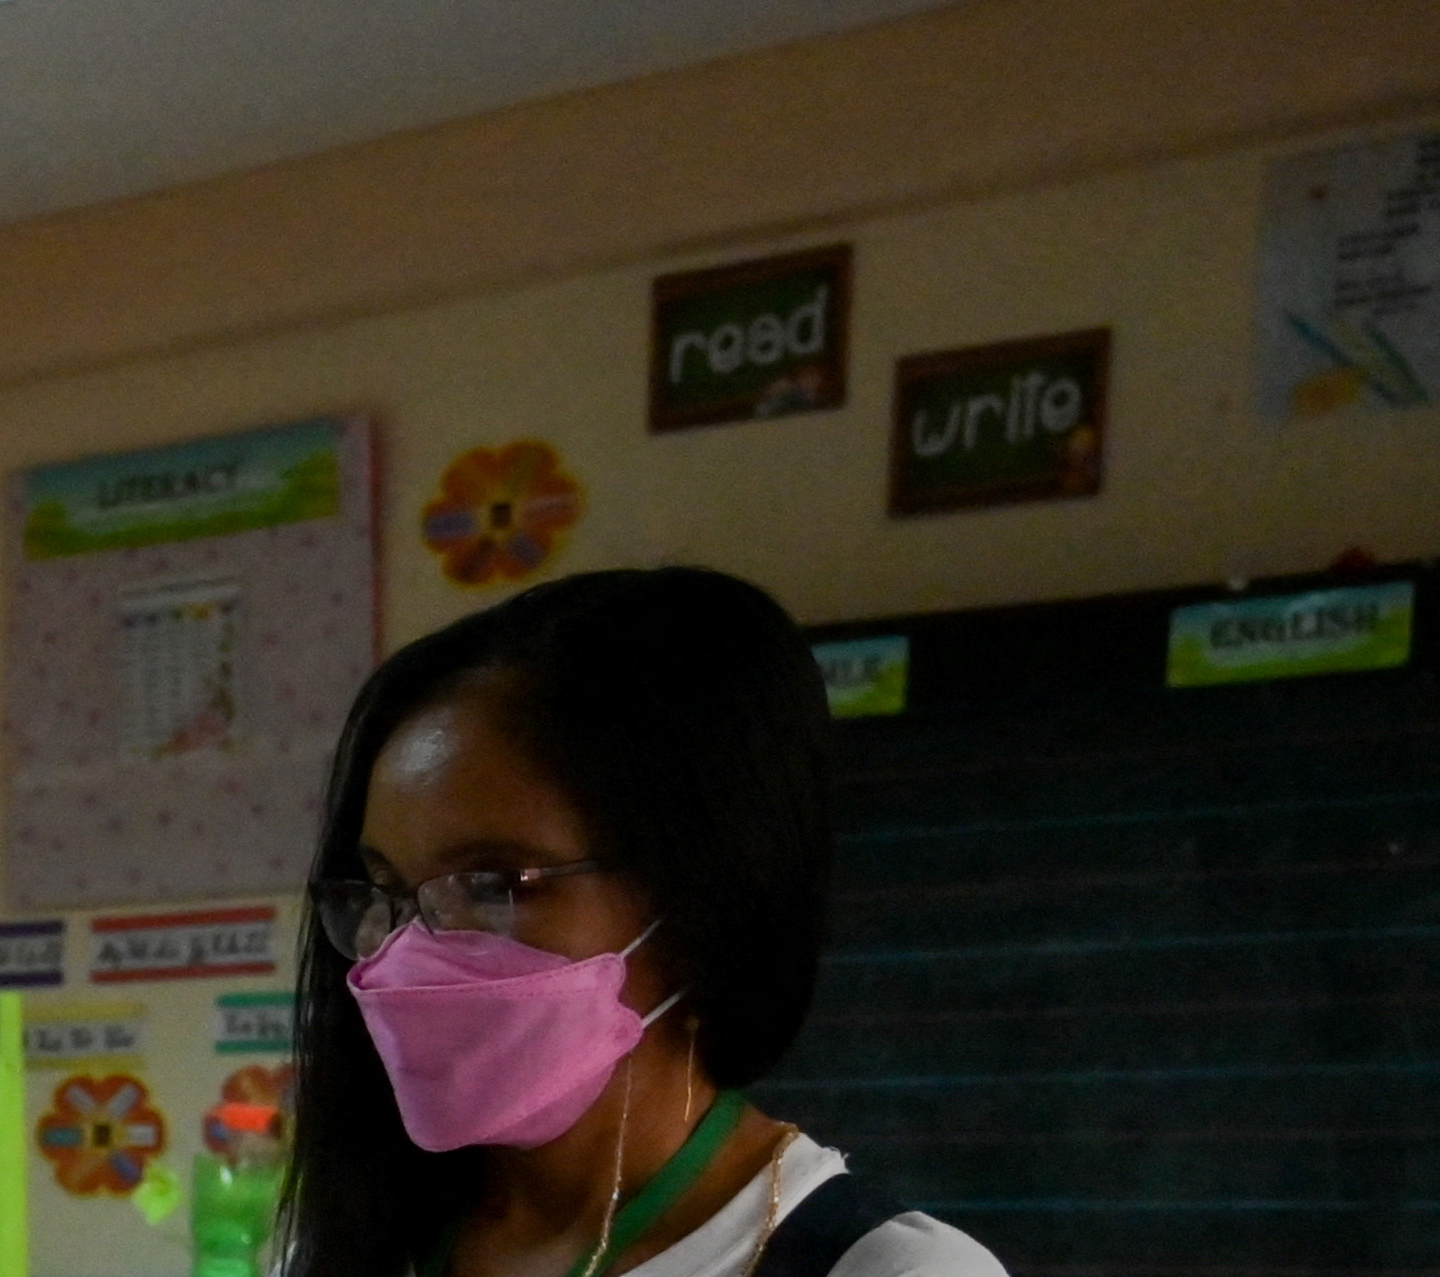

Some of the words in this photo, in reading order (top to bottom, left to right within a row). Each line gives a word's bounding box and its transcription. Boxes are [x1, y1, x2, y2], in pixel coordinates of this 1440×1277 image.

[668, 283, 830, 384] read
[910, 371, 1081, 457] write
[1209, 604, 1381, 650] ENGLISH
